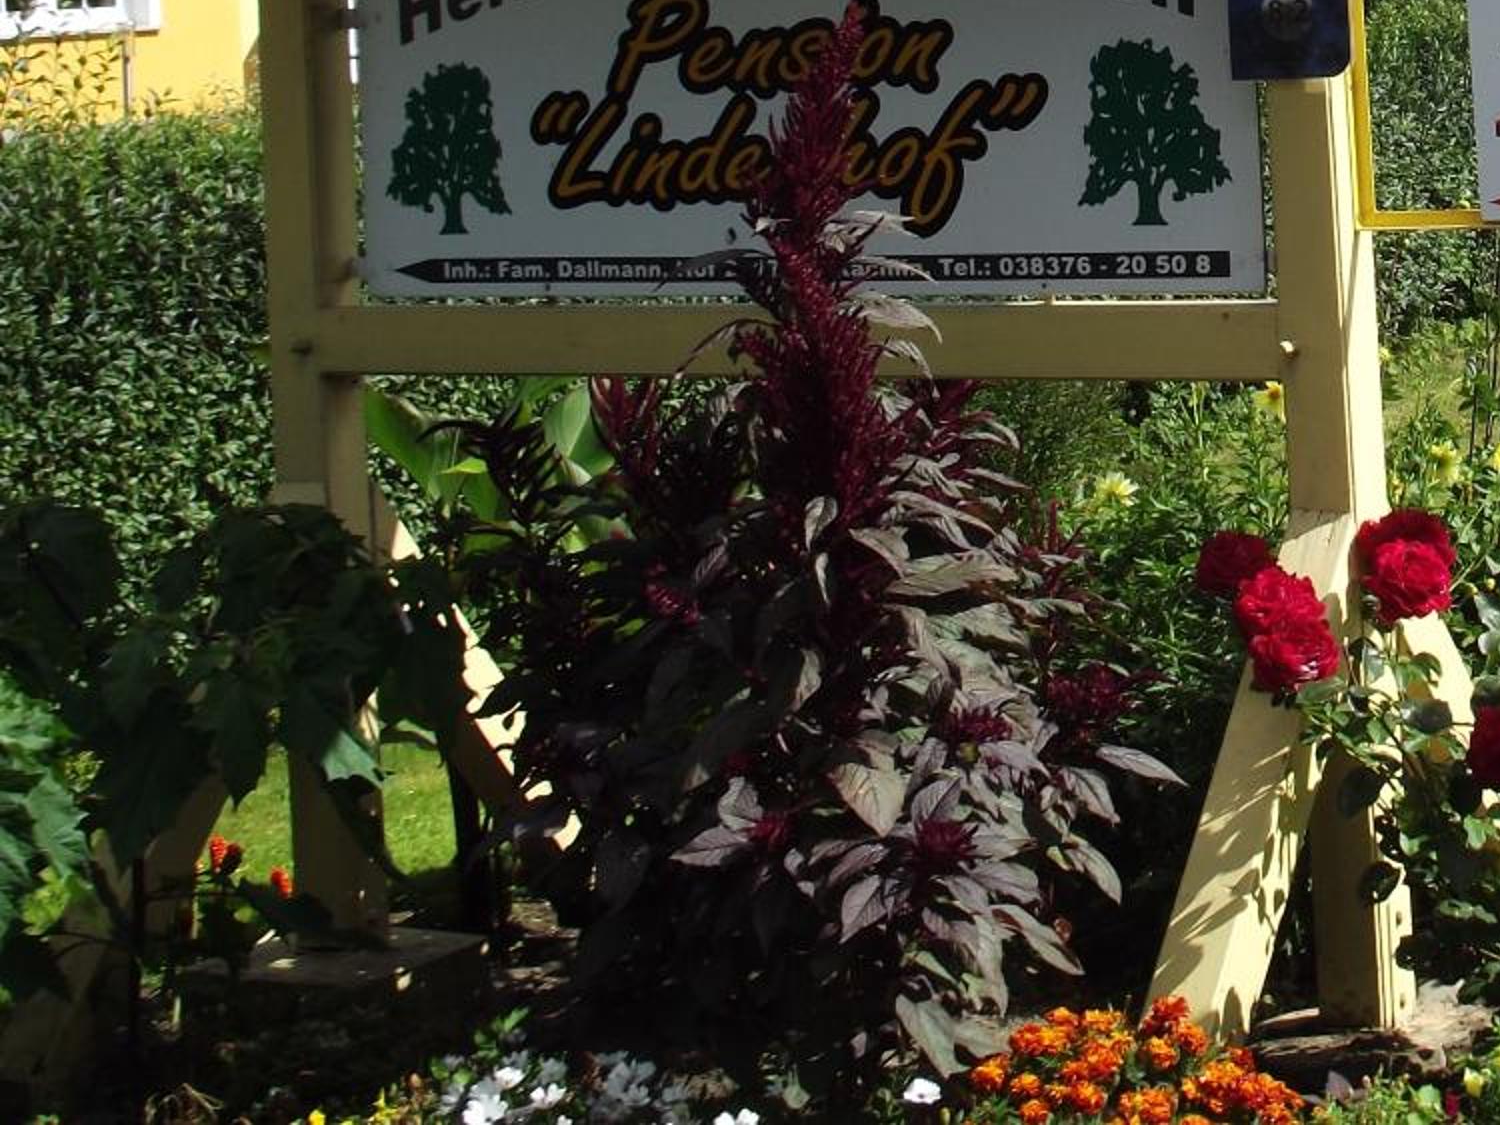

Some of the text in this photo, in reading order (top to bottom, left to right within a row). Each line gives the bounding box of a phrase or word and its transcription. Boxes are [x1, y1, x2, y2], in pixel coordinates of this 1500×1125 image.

[499, 260, 549, 279] Fam.
[938, 258, 991, 276] Tel.:
[999, 256, 1091, 276] 038376
[1115, 255, 1147, 275] 20
[1156, 254, 1188, 274] 50
[1195, 254, 1211, 274] 8
